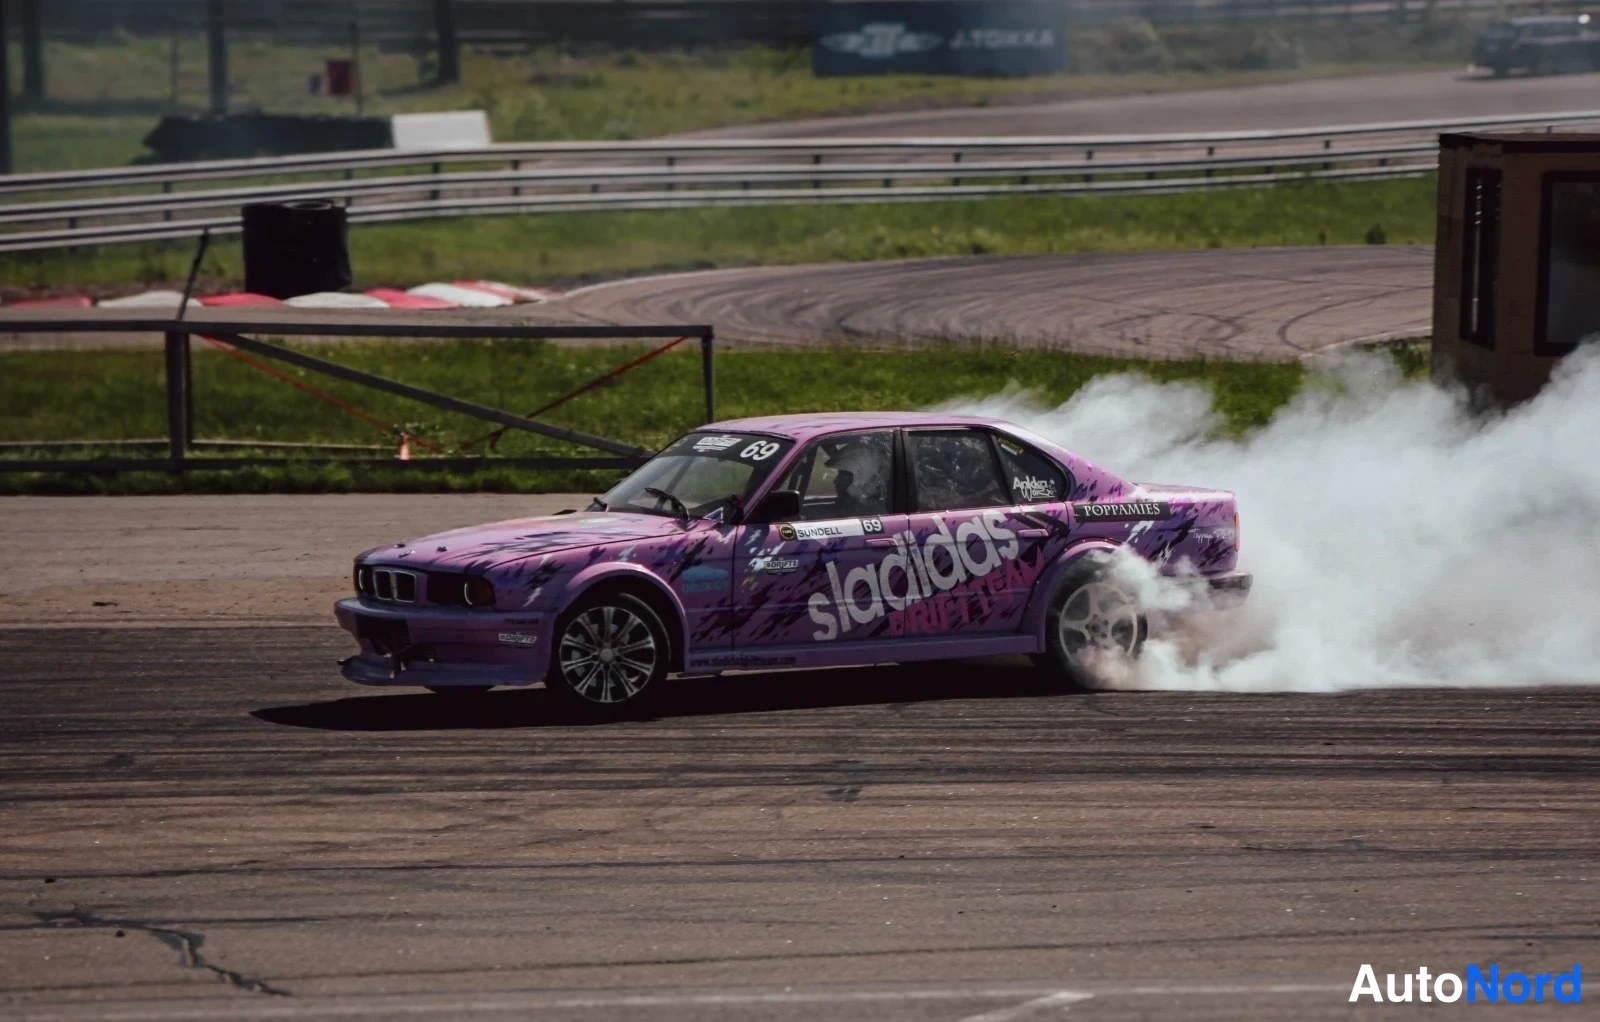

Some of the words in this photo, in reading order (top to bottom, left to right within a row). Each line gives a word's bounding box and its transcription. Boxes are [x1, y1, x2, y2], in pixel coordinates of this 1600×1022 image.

[740, 440, 780, 461] 69
[1084, 503, 1161, 517] POPPAMIES
[798, 526, 843, 538] SUNDELL
[863, 519, 882, 532] 69
[807, 508, 1019, 641] sladidas
[888, 584, 971, 637] DRIFT
